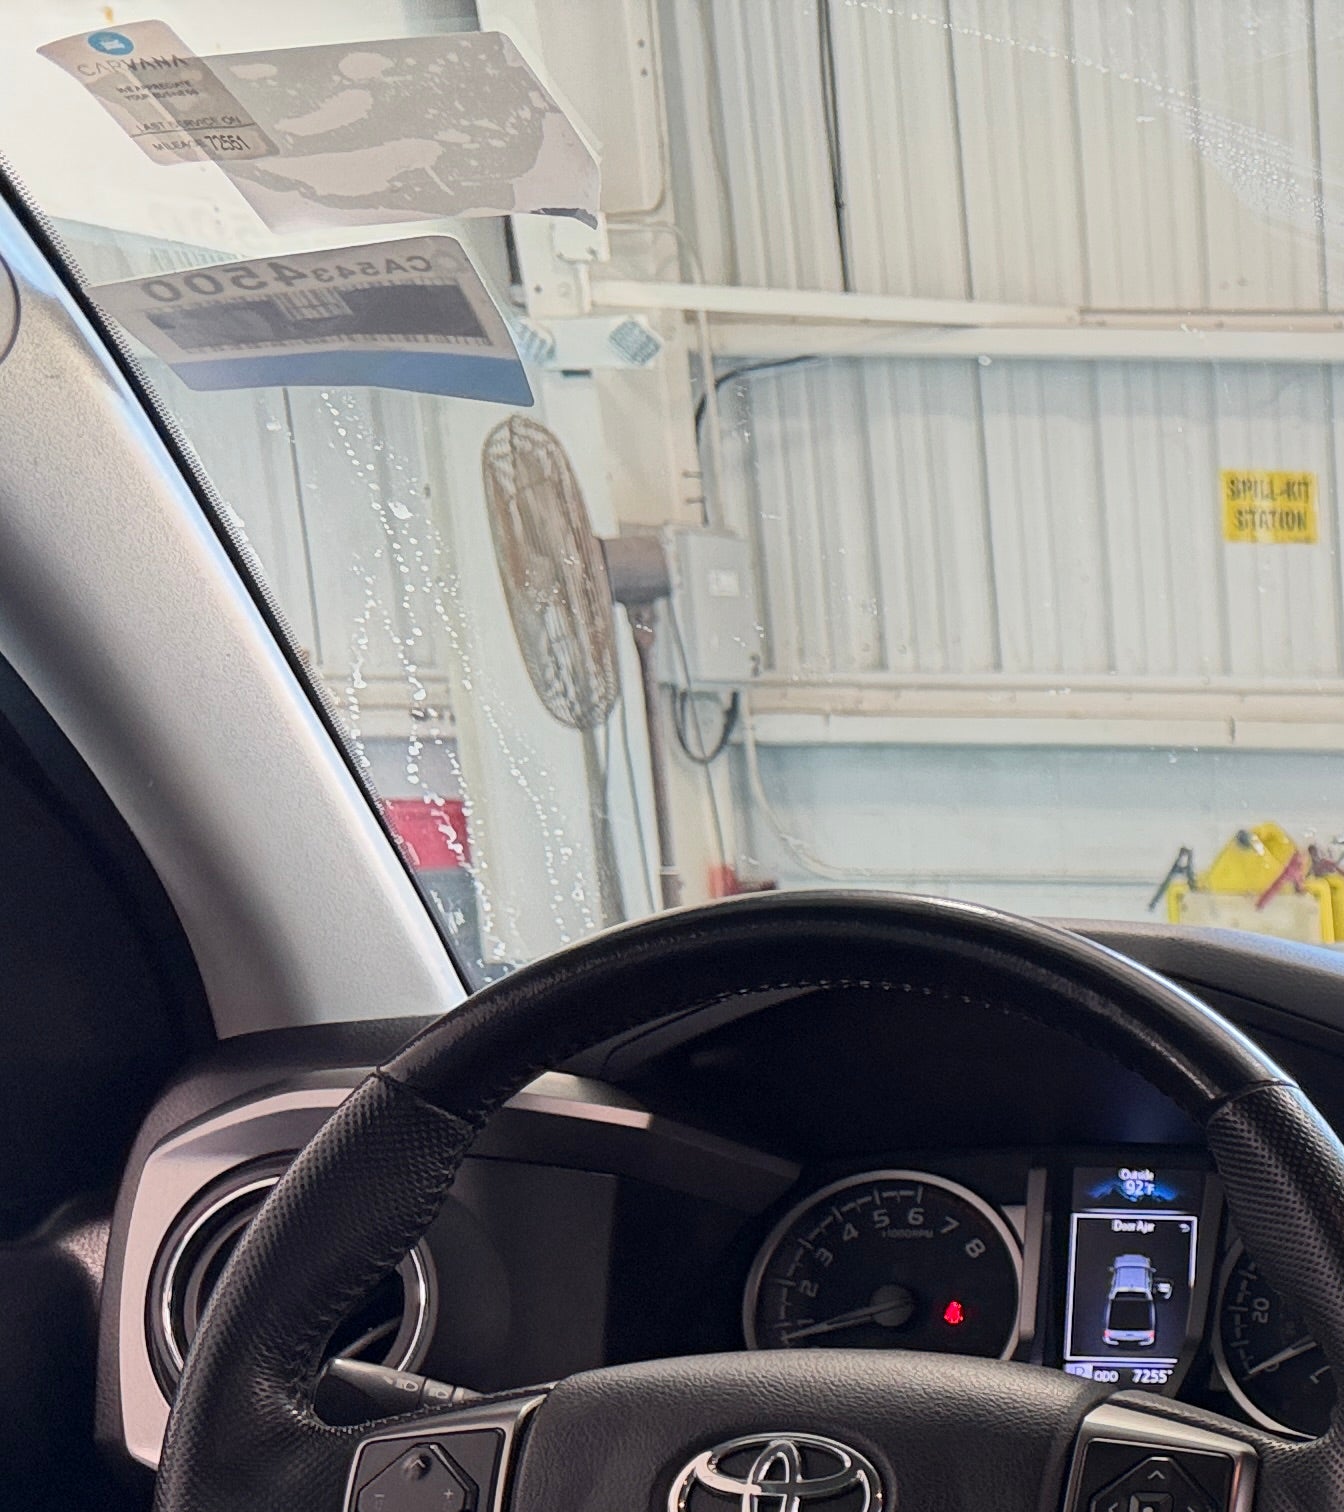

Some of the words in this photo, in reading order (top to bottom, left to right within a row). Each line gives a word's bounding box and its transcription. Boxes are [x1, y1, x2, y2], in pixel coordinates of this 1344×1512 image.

[78, 54, 190, 77] CARVANA
[204, 134, 251, 151] 72551
[1235, 509, 1308, 532] STATION
[873, 1209, 891, 1229] 5
[907, 1207, 926, 1225] 6
[940, 1215, 960, 1235] 7
[842, 1223, 860, 1242] 4
[964, 1237, 987, 1258] 8
[815, 1248, 835, 1268] 3
[798, 1279, 820, 1299] 2
[1252, 1297, 1271, 1325] 20
[1131, 1368, 1175, 1385] 7255
